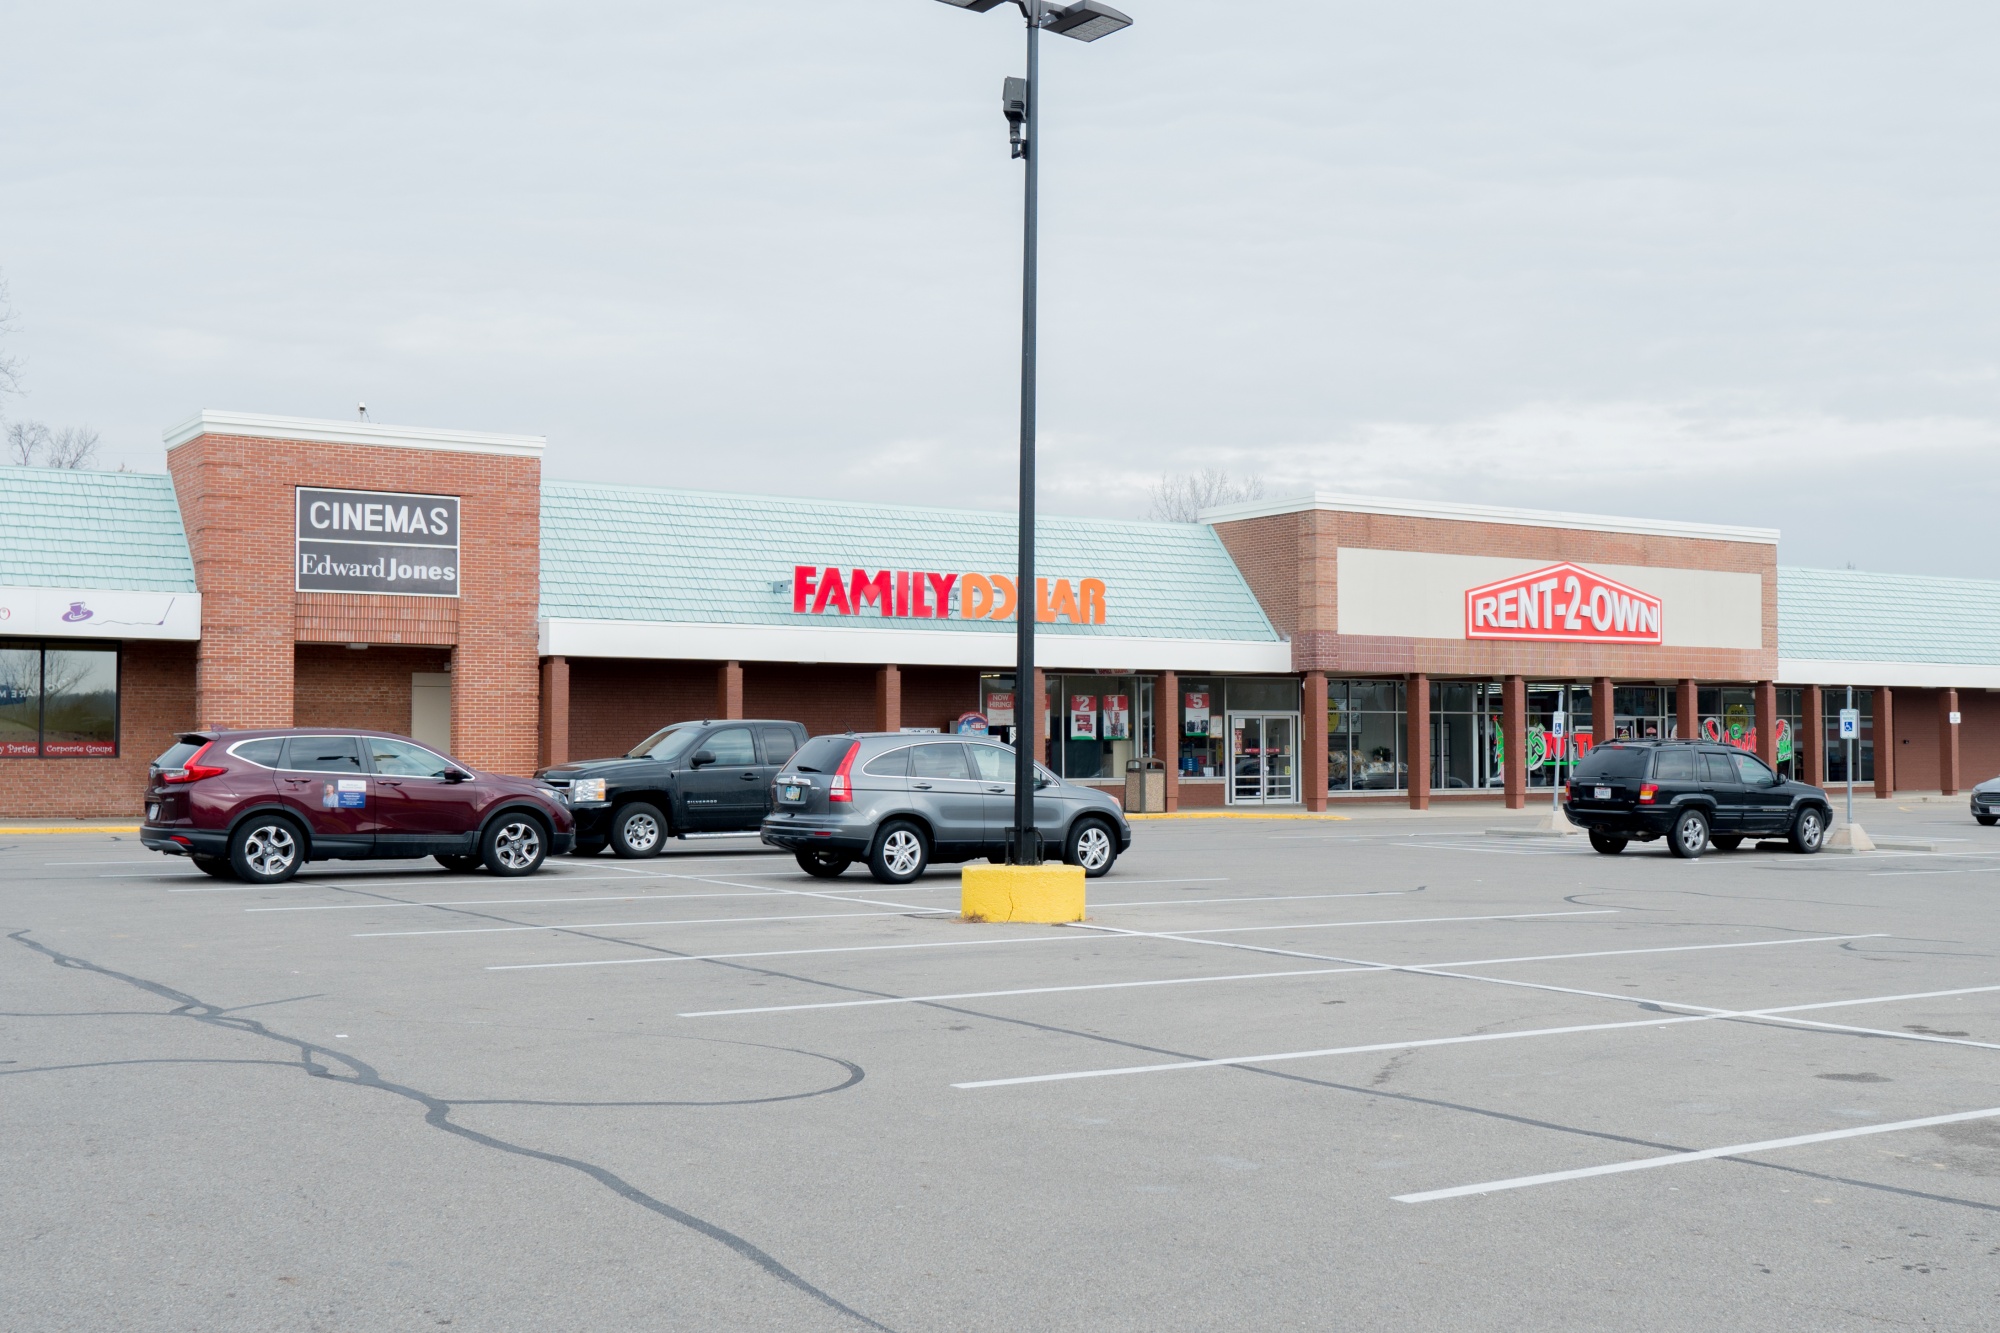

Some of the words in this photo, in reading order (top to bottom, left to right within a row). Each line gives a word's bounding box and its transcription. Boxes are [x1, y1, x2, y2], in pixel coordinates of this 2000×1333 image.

[309, 501, 449, 536] CINEMAS
[300, 553, 386, 578] Edward
[387, 557, 456, 581] Jones
[792, 565, 959, 619] FAMILY
[960, 572, 1106, 625] DOLAR
[1475, 575, 1658, 633] RENT-2-OWN
[1076, 696, 1090, 711] $2
[1190, 694, 1203, 709] $5
[7, 744, 37, 754] Parties
[46, 744, 84, 754] Corporate
[86, 745, 113, 755] Groups
